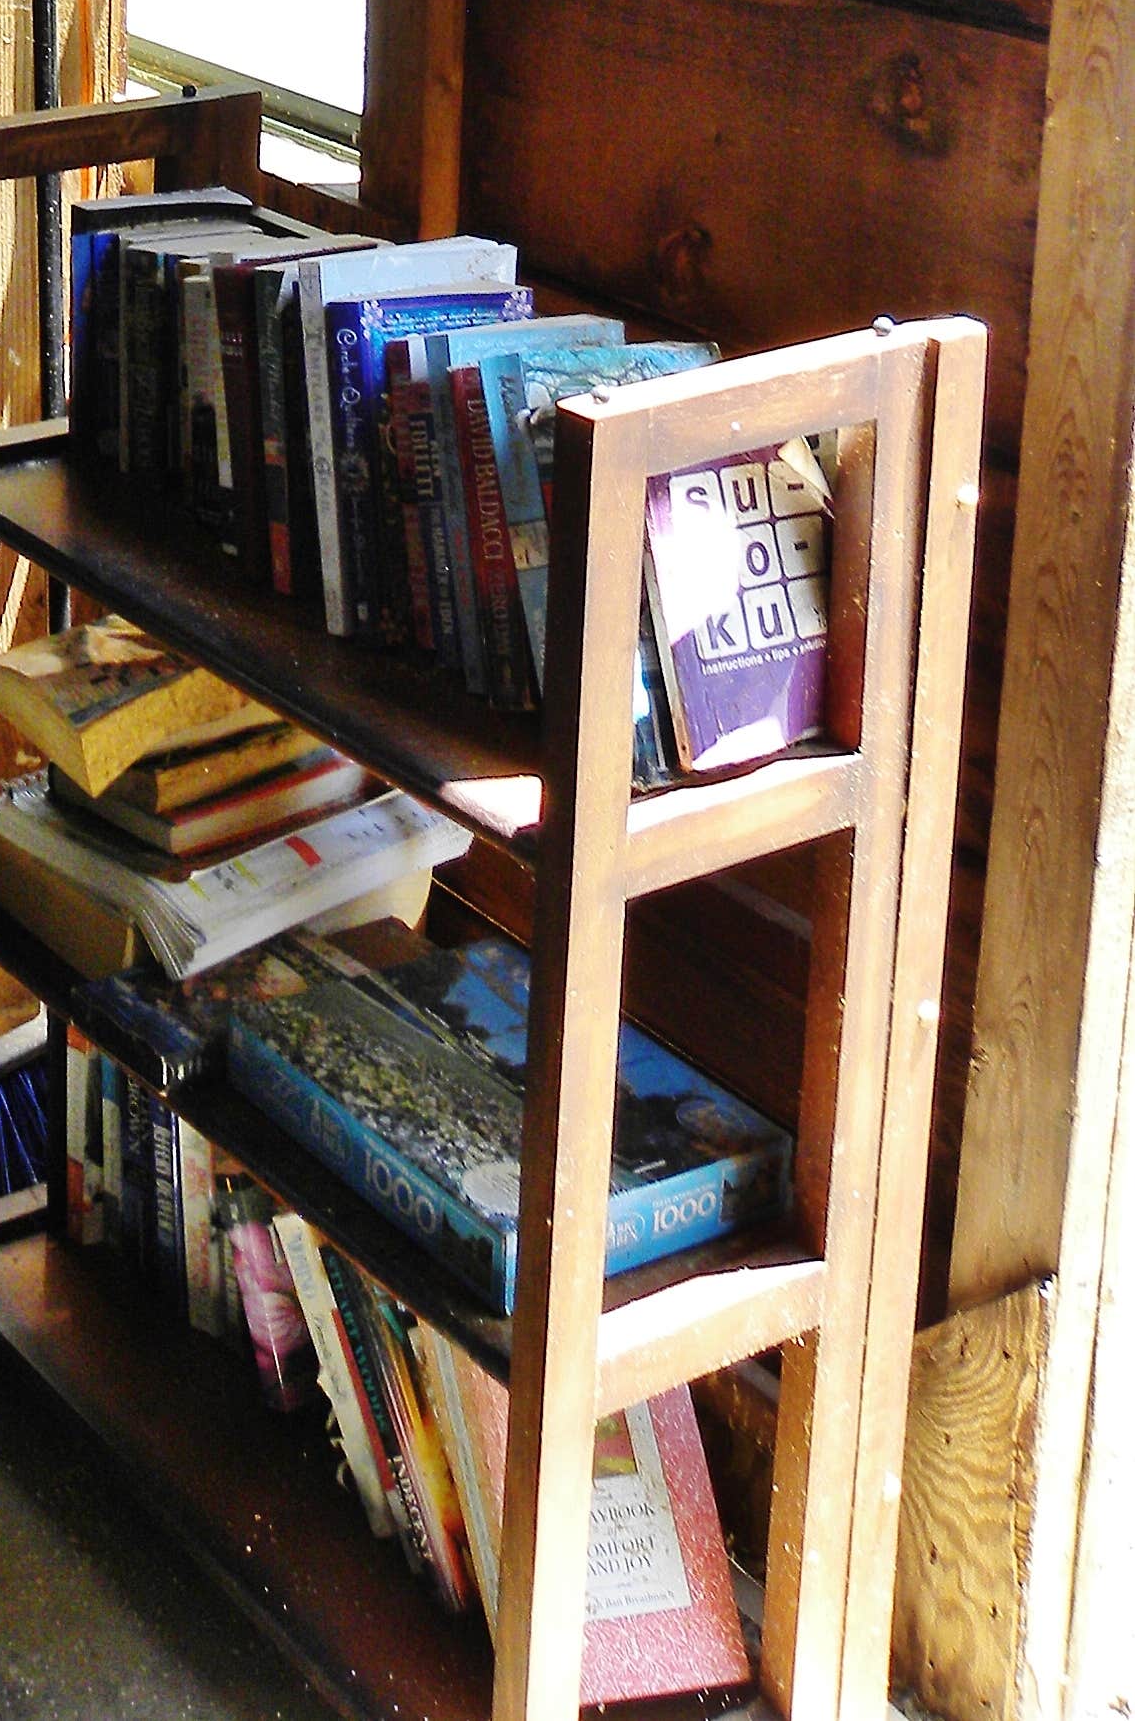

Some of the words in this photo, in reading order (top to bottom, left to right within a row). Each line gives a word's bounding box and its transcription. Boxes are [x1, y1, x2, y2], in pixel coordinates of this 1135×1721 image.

[335, 327, 360, 374] Circle
[337, 385, 365, 449] Quilters
[464, 396, 491, 460] DAVID
[408, 418, 434, 499] FOLLETT
[470, 462, 503, 564] BALDACCI
[430, 525, 448, 584] HAMMER
[438, 599, 454, 636] EDEN
[702, 655, 763, 676] Instructions
[771, 647, 790, 663] tips
[367, 1146, 438, 1236] 1000
[651, 1191, 719, 1234] 1000
[624, 1556, 650, 1575] JOY
